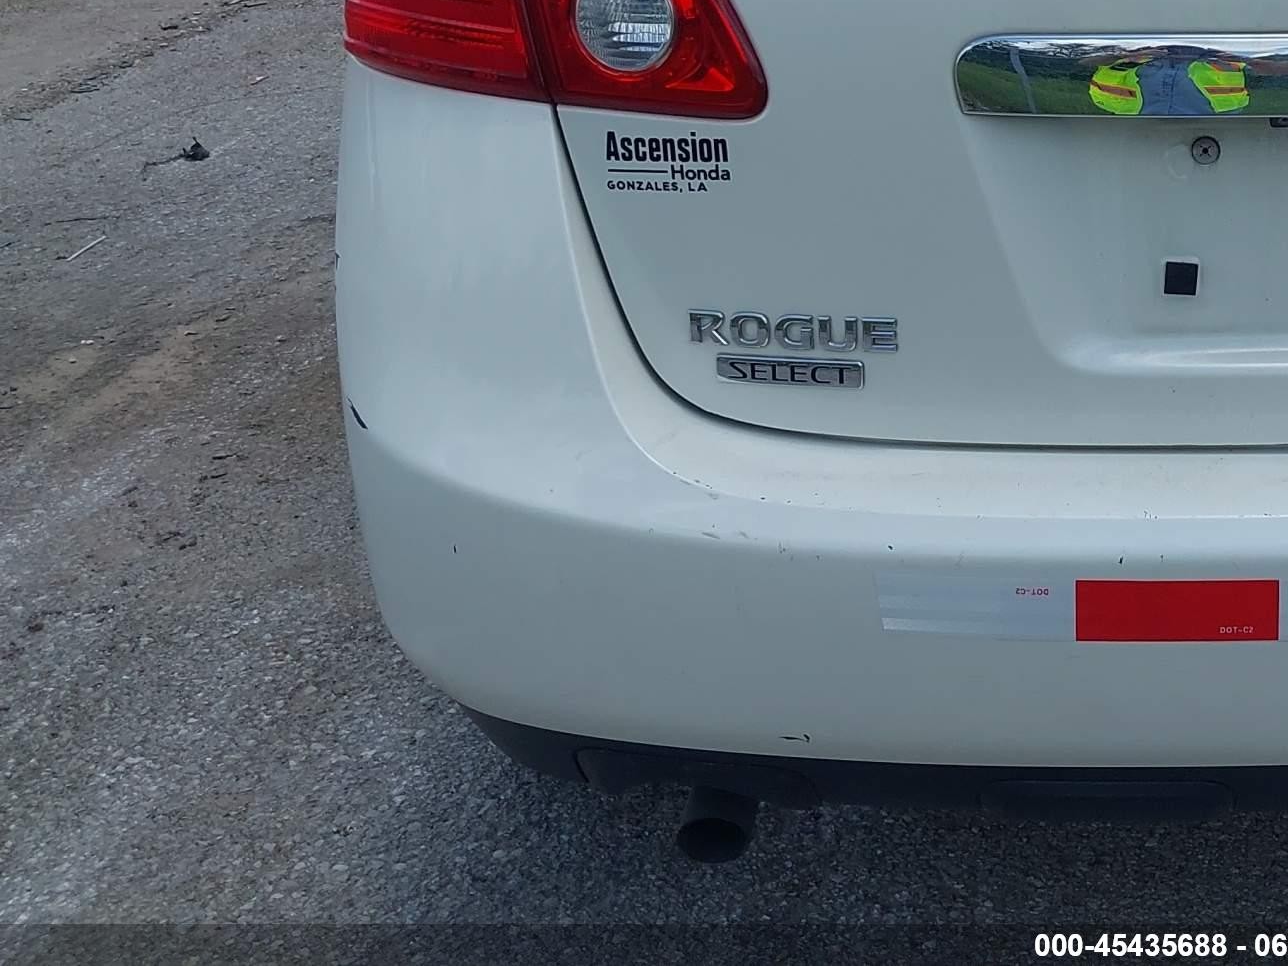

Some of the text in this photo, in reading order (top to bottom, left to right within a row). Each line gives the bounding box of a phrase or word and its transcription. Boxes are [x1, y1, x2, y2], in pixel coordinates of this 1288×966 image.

[606, 131, 729, 163] Ascension
[671, 164, 731, 181] Honda
[606, 180, 708, 193] GONZALES, LA
[688, 309, 899, 353] ROGUE
[728, 361, 851, 385] SELECT
[1015, 587, 1049, 596] DOT-C2
[1219, 626, 1254, 634] DOT-C2
